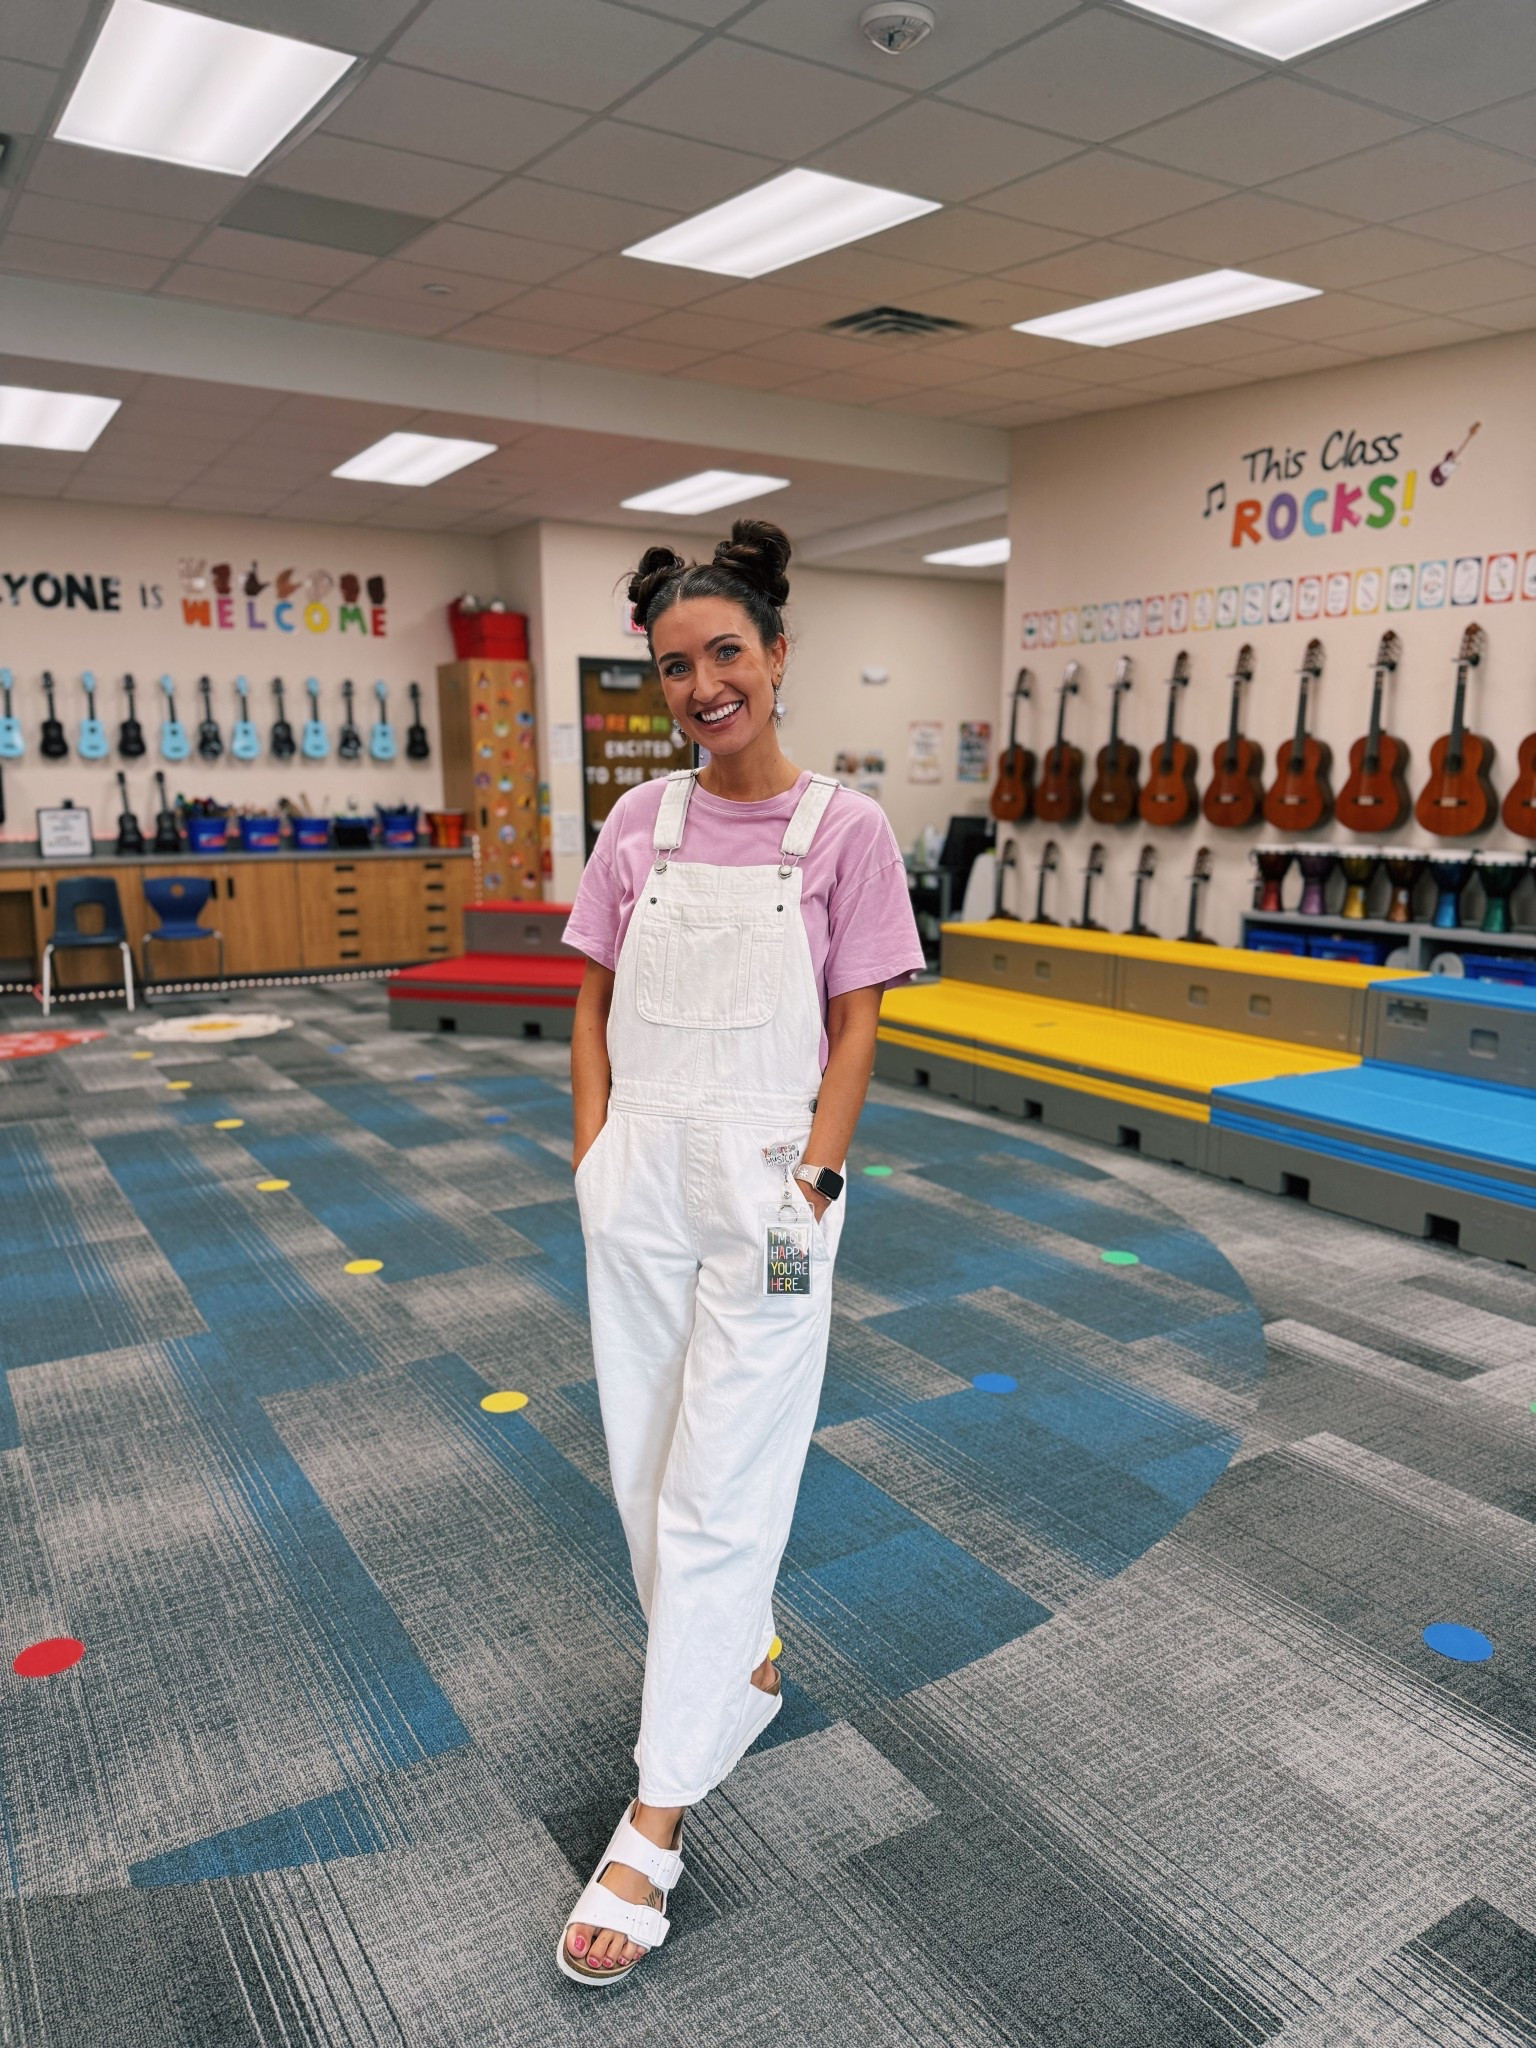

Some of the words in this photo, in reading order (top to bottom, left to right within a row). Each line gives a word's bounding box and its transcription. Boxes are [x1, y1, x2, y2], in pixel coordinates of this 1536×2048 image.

[1242, 446, 1307, 484] This
[1321, 428, 1403, 472] Class
[1230, 469, 1418, 548] ROCKS!
[0, 571, 121, 612] YONE
[140, 584, 163, 610] IS
[181, 597, 387, 638] WELCOME
[604, 739, 673, 759] EXCITED
[586, 765, 610, 785] TO
[614, 766, 644, 785] SEE
[770, 1261, 809, 1276] YOU'RE
